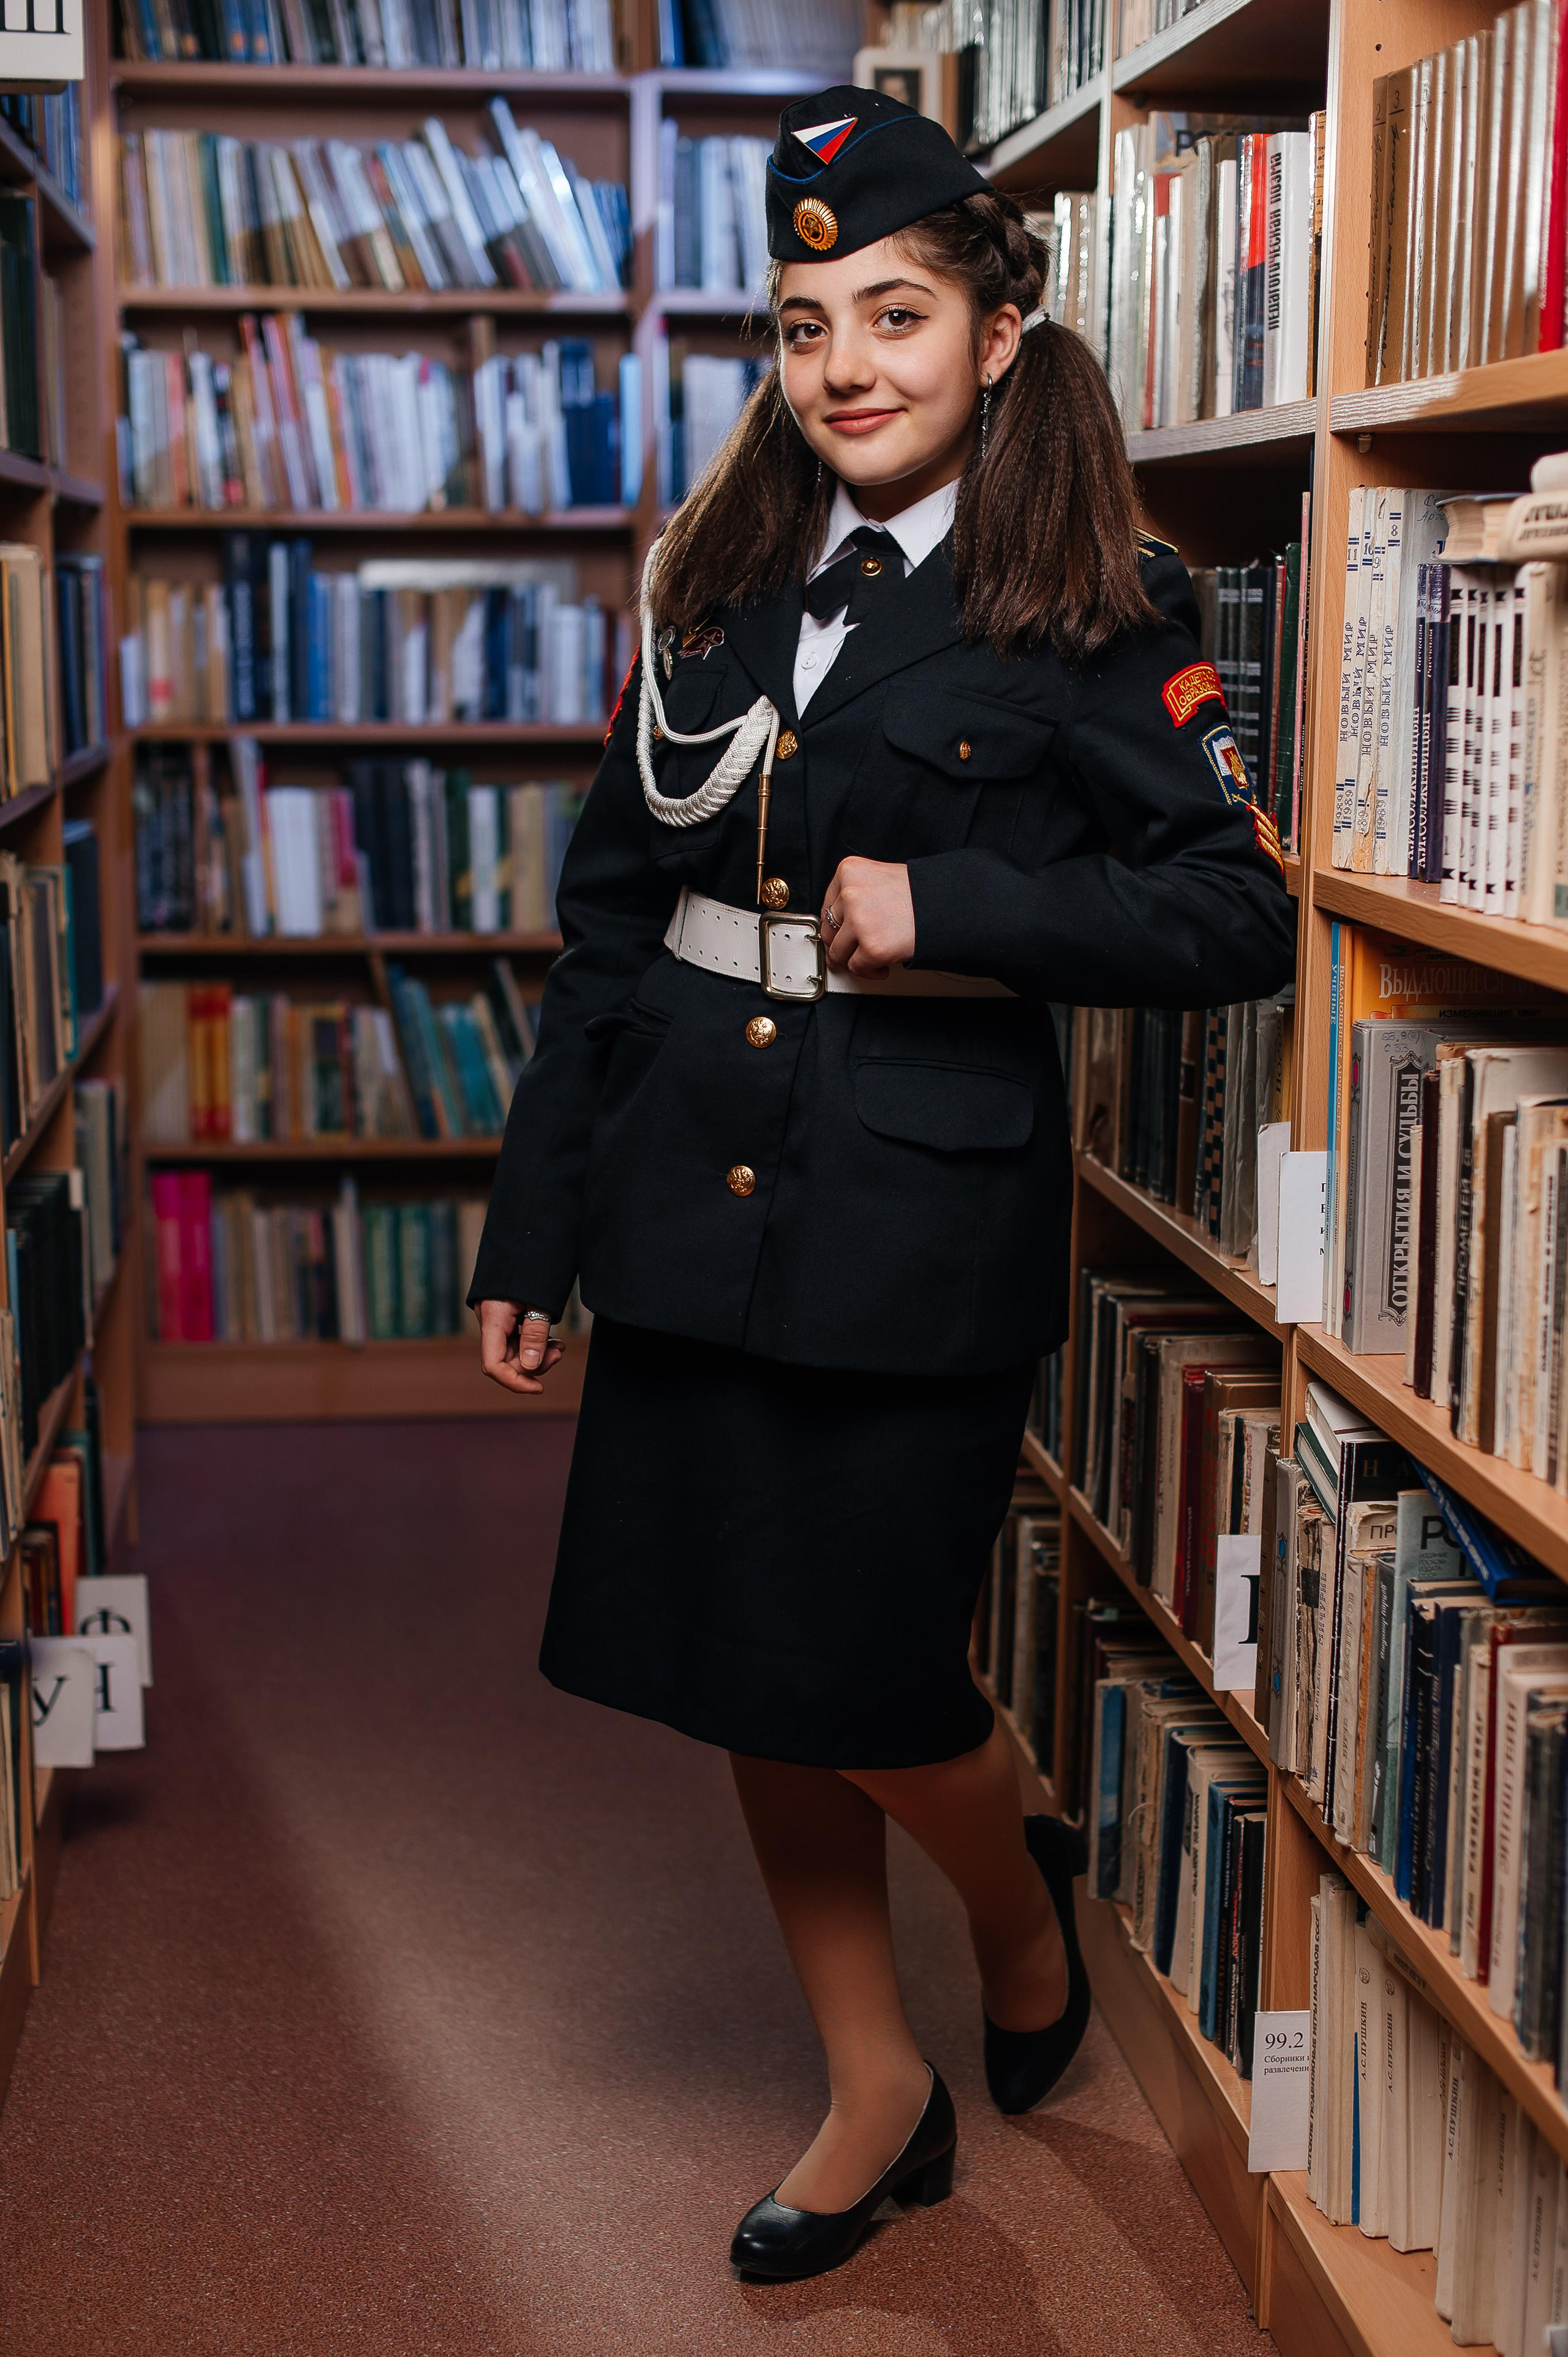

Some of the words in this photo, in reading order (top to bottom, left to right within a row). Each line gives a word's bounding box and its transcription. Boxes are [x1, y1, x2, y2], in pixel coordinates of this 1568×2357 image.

[1390, 524, 1398, 537] 8
[1347, 548, 1358, 561] 11
[1373, 556, 1381, 569] 9
[1343, 622, 1354, 662] МИР
[1355, 616, 1367, 657] МИР
[1366, 634, 1378, 673] МИР
[1383, 625, 1394, 666] МИР
[1340, 672, 1351, 743] НОВЫЙ
[1350, 667, 1363, 738] НОВЫЙ
[1362, 686, 1375, 756] НОВЫЙ
[1380, 676, 1392, 747] НОВЫЙ
[1335, 794, 1344, 825] 1989
[1343, 789, 1354, 820] 1989
[1376, 799, 1387, 831] 1989
[1330, 964, 1338, 1025] УЧЕНЫЕ
[1439, 1009, 1513, 1019] ИЗМЕНИВШИЕ
[1397, 1073, 1419, 1158] СУДЬБЫ
[1391, 1187, 1411, 1307] ОТКРЫТИЯ
[1317, 1572, 1327, 1646] МИЧУРИН
[1312, 1943, 1321, 2001] НАРОДОВ
[1264, 2055, 1305, 2064] Сборники
[1265, 2032, 1304, 2050] 99.2
[1264, 2065, 1309, 2076] развлечени
[1449, 2076, 1459, 2136] ПУШКИН
